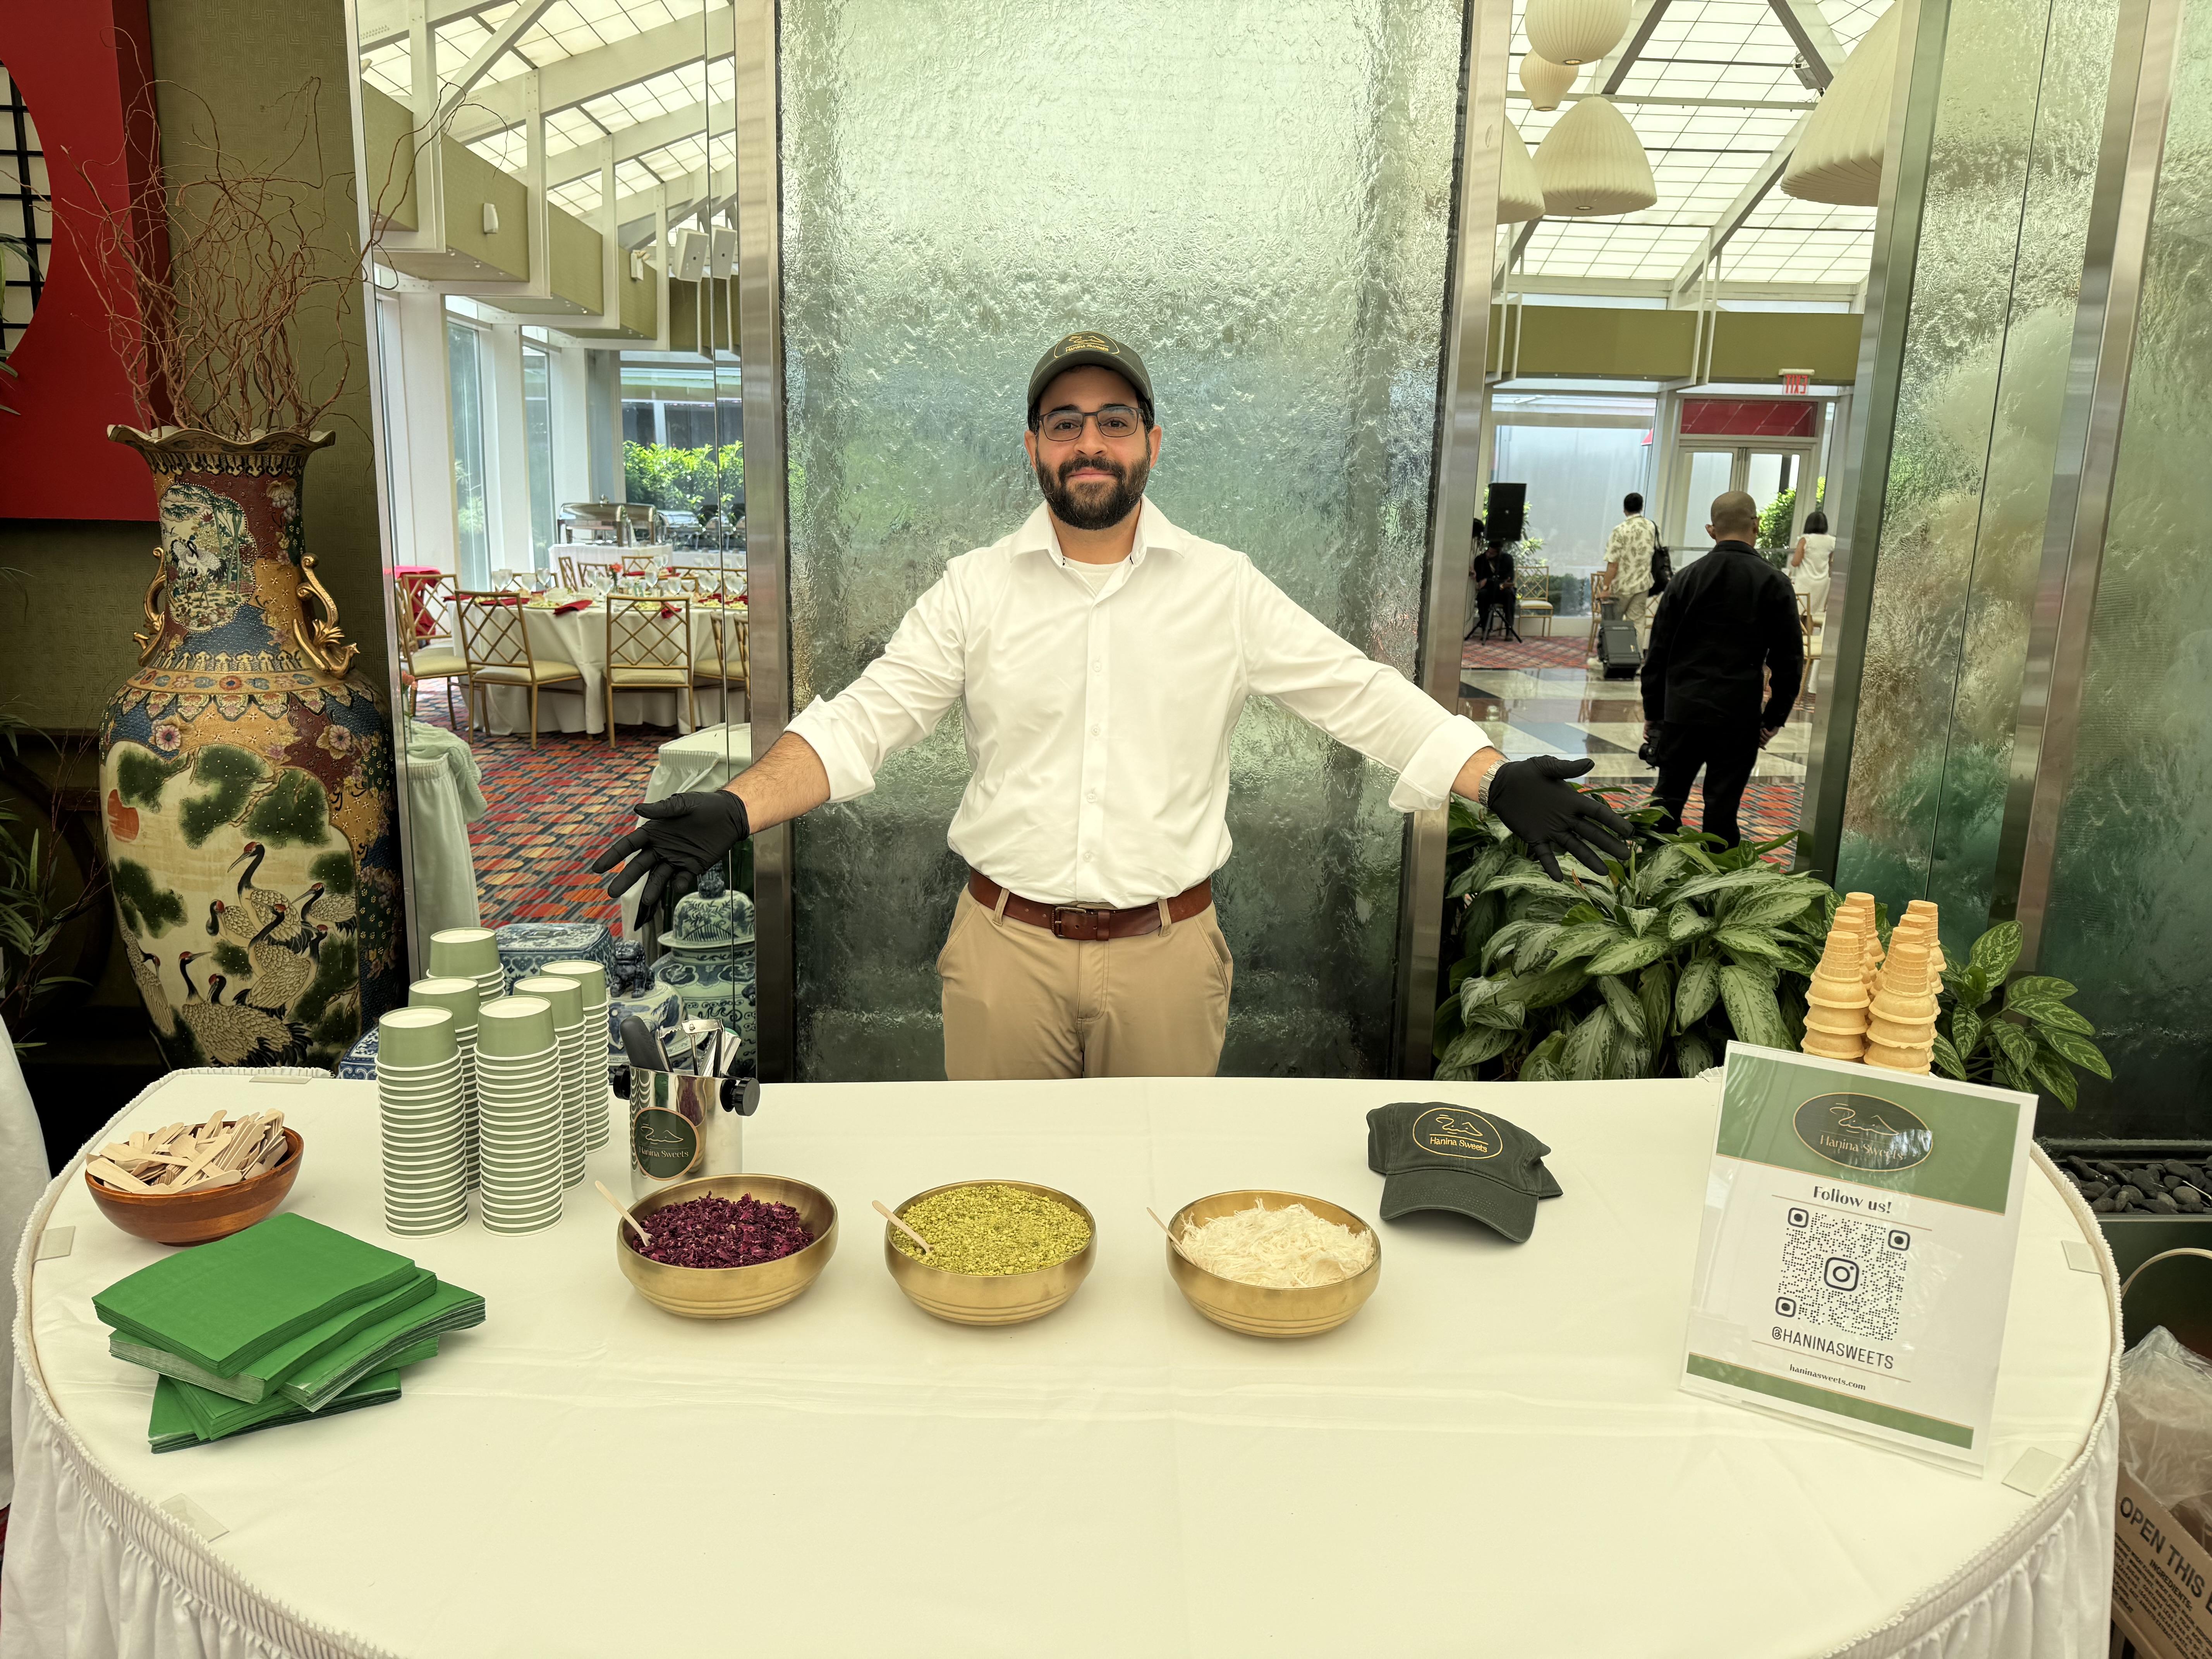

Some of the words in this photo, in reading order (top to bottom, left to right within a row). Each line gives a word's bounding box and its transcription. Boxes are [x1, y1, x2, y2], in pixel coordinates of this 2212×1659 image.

[639, 1146, 659, 1158] Hanina
[661, 1150, 689, 1158] Sweets
[1430, 1137, 1457, 1146] Hanina
[1459, 1139, 1487, 1153] Sweets
[1820, 1135, 1858, 1152] Hanina
[1862, 1144, 1904, 1161] Sweets
[1813, 1186, 1863, 1207] Follow
[1868, 1201, 1892, 1214] us!
[1772, 1326, 1894, 1369] @HANINASWEETS
[1790, 1364, 1866, 1391] haninasweets.com
[2120, 1497, 2166, 1554] OPEN
[2167, 1544, 2205, 1597] THIS
[2150, 1559, 2193, 1612] INGREDIENTS:
